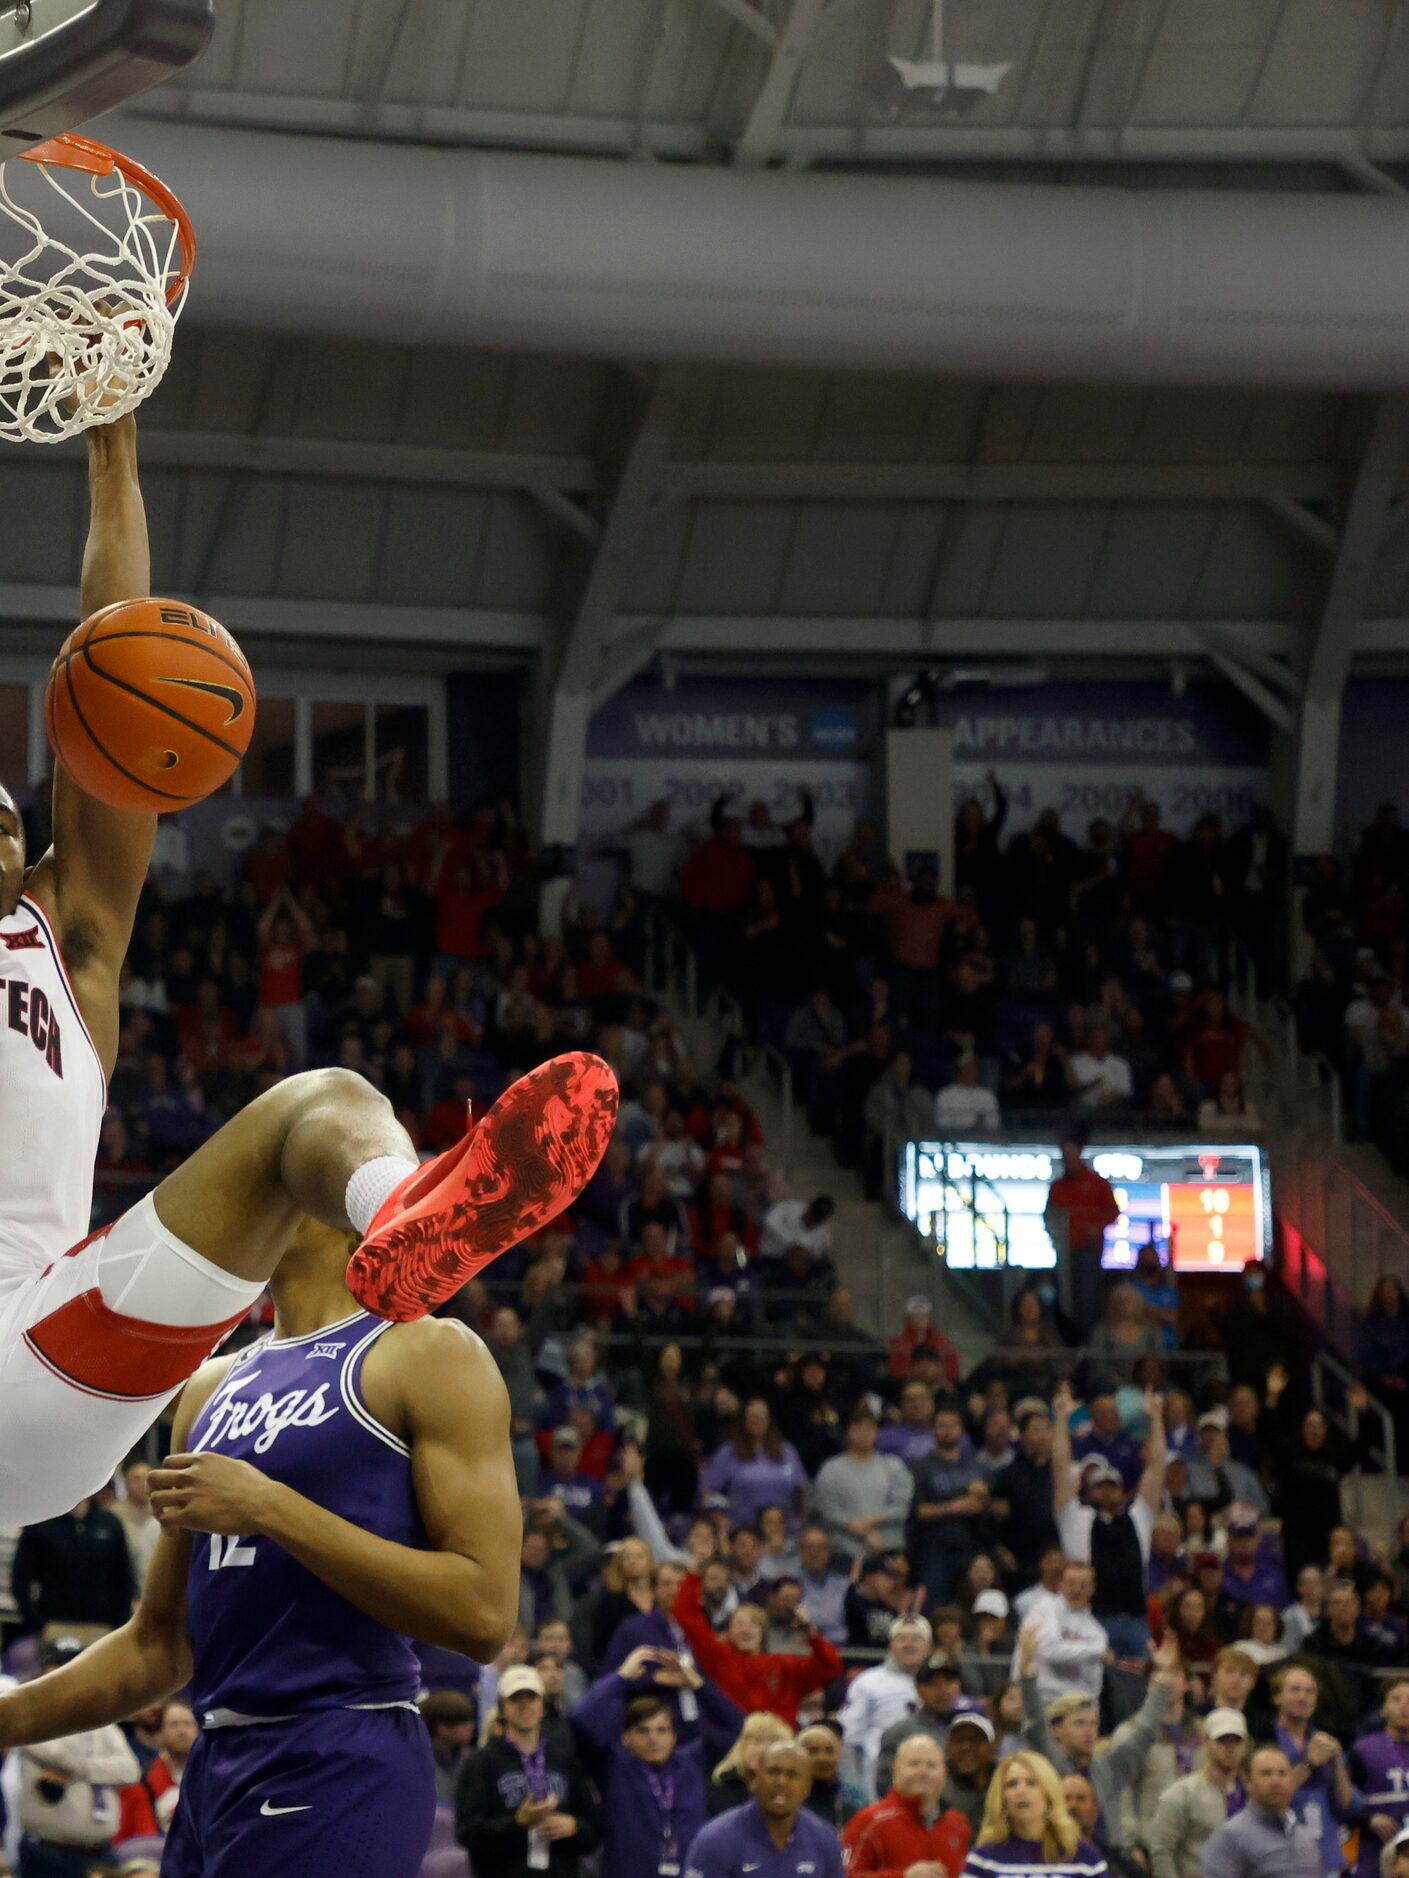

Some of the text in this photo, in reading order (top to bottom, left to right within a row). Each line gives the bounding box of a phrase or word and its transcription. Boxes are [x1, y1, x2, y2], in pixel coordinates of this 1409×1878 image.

[636, 713, 798, 746] WOMEN'S
[953, 716, 1197, 752] APPEARANCES
[953, 780, 1032, 809] 204
[192, 1369, 340, 1455] Frogs
